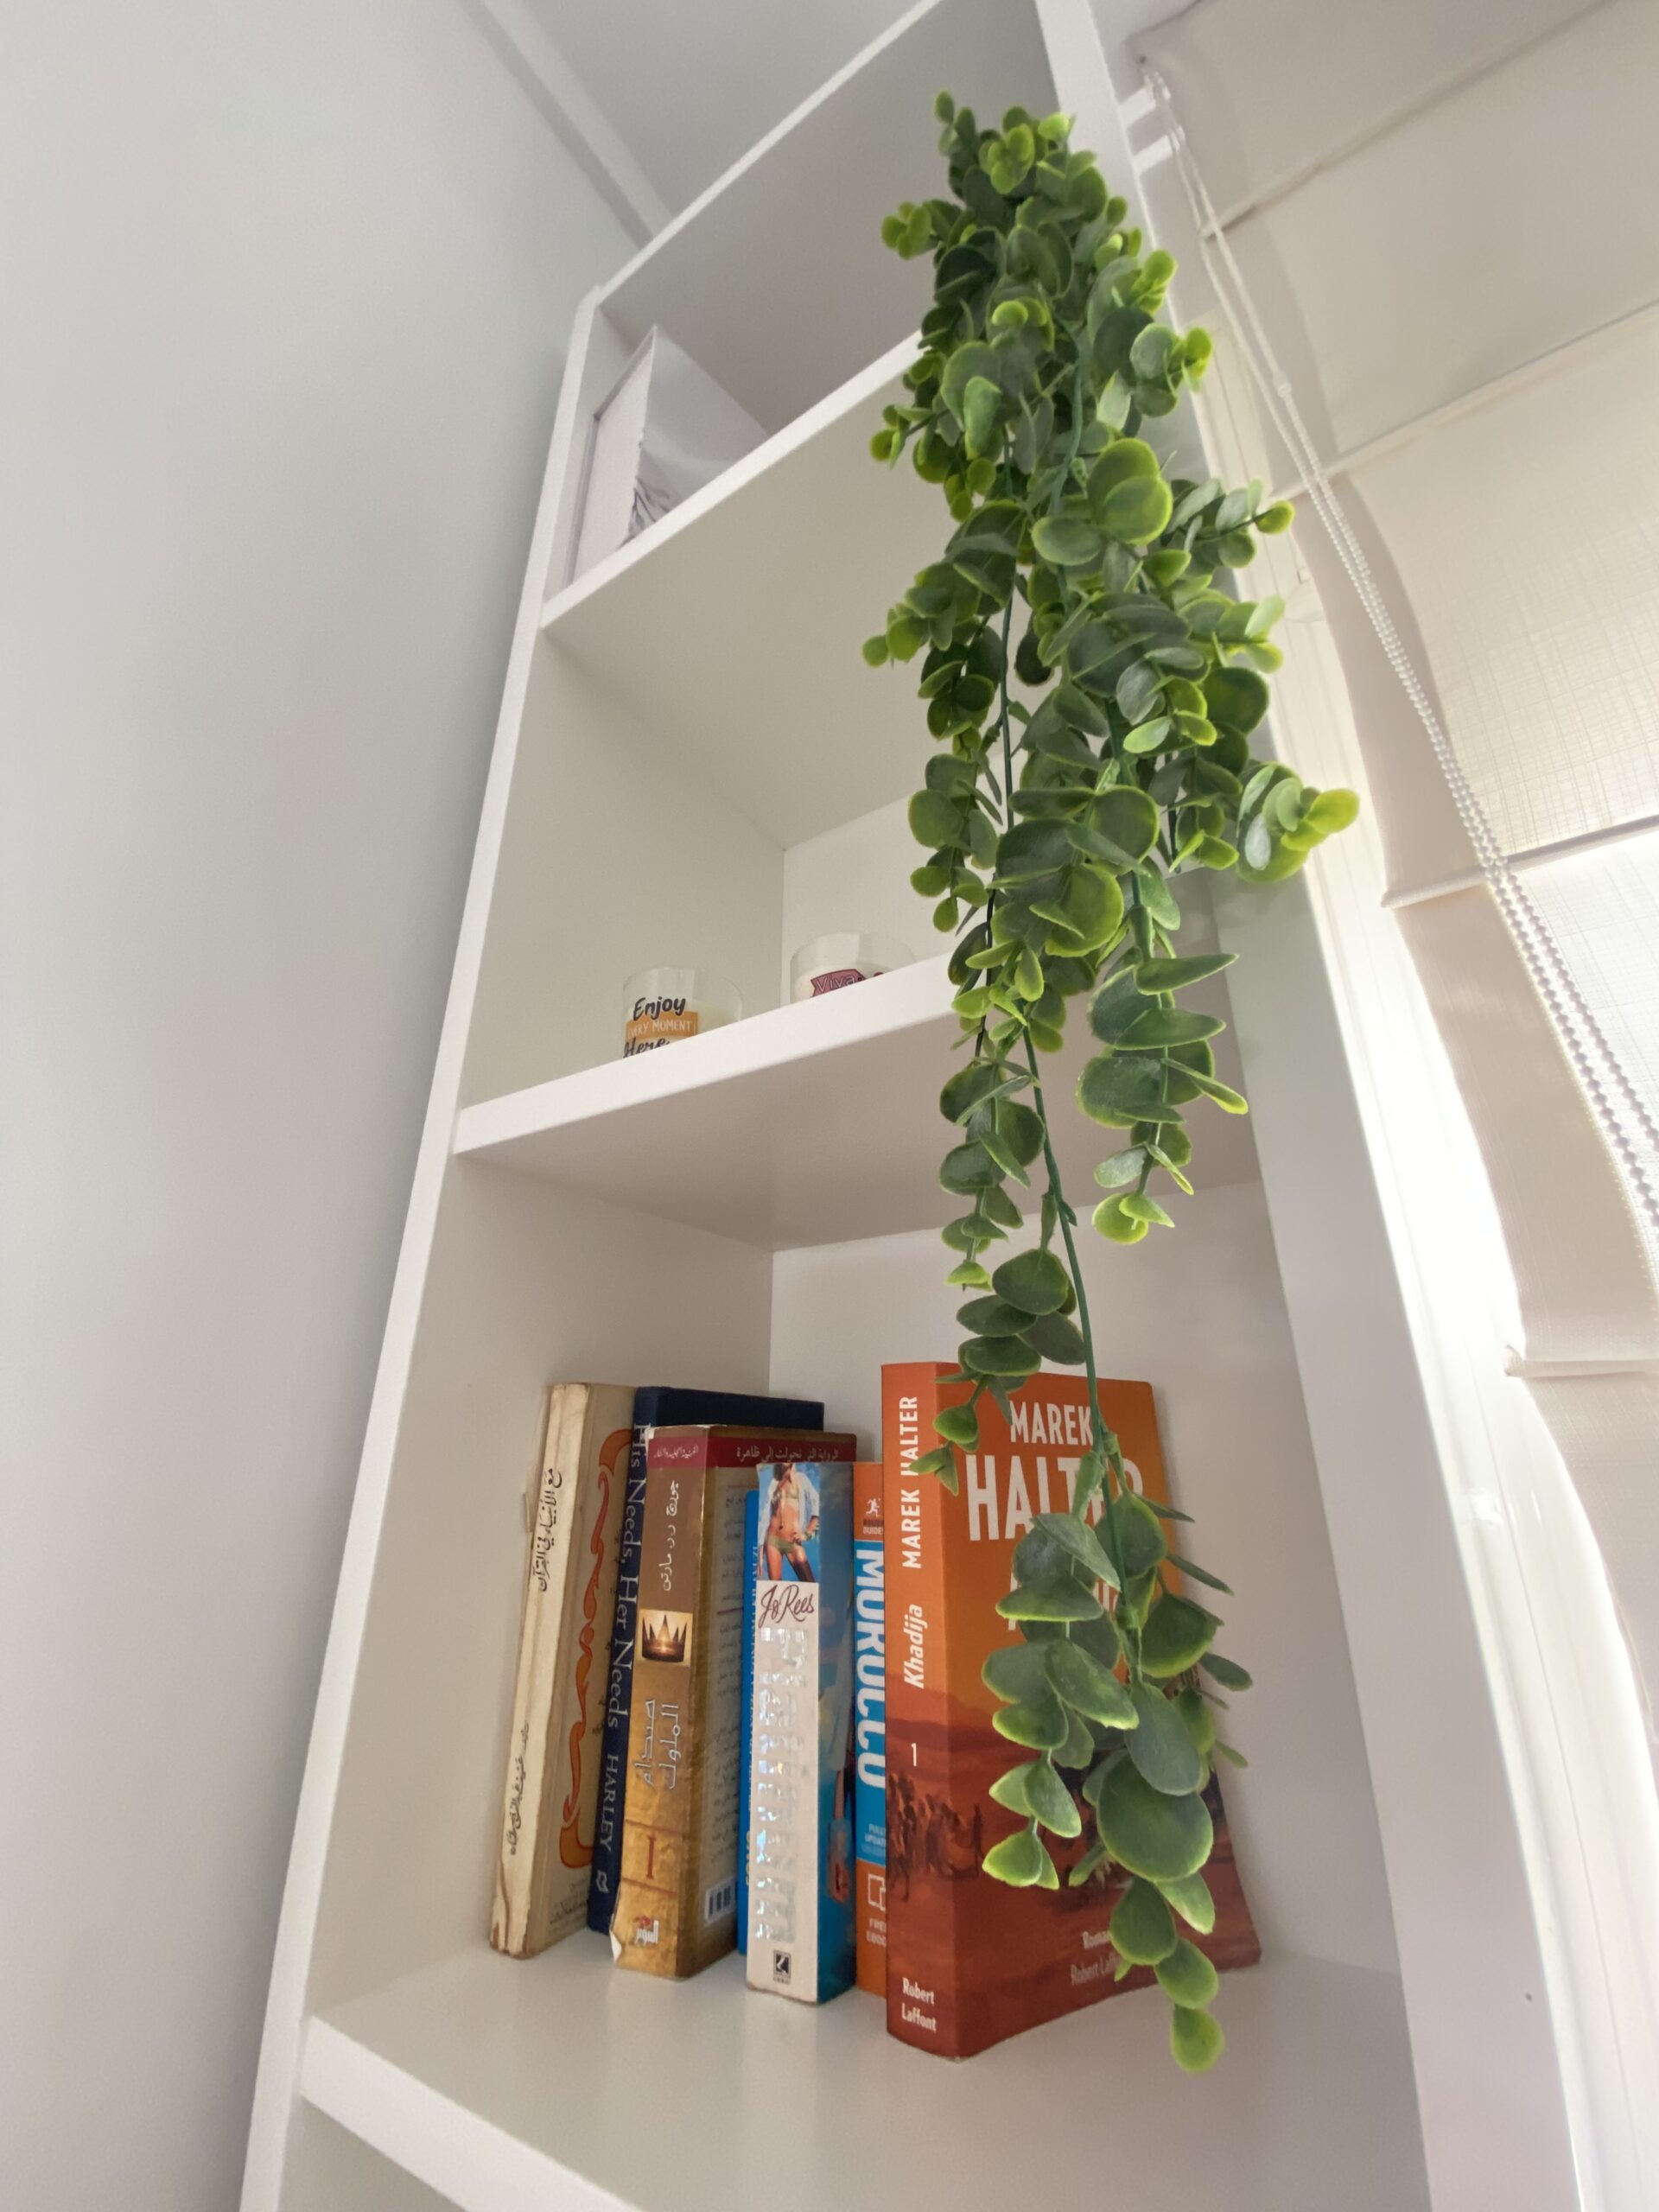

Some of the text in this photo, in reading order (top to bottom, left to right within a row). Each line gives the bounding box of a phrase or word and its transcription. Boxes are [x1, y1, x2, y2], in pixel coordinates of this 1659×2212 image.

[816, 976, 855, 992] Viva
[632, 996, 686, 1021] Enjoy
[652, 1020, 691, 1033] MOMENT
[631, 1422, 651, 1468] His
[1009, 1400, 1095, 1446] MAREK
[736, 1445, 760, 1462] ظاهرة
[965, 1454, 1143, 1541] HALT
[901, 1489, 922, 1568] MAREK
[658, 1554, 673, 1591] مارتن
[617, 1573, 639, 1631] Her
[758, 1584, 815, 1628] Jo Rees
[856, 1549, 886, 1789] MOROCCO
[903, 1603, 929, 1689] Khadija
[607, 1638, 634, 1728] Needs
[658, 1702, 682, 1789] الملوك
[911, 1742, 918, 1767] 1
[600, 1753, 619, 1853] HARLEY
[902, 1976, 935, 2005] Robert
[902, 2001, 938, 2033] Laffont
